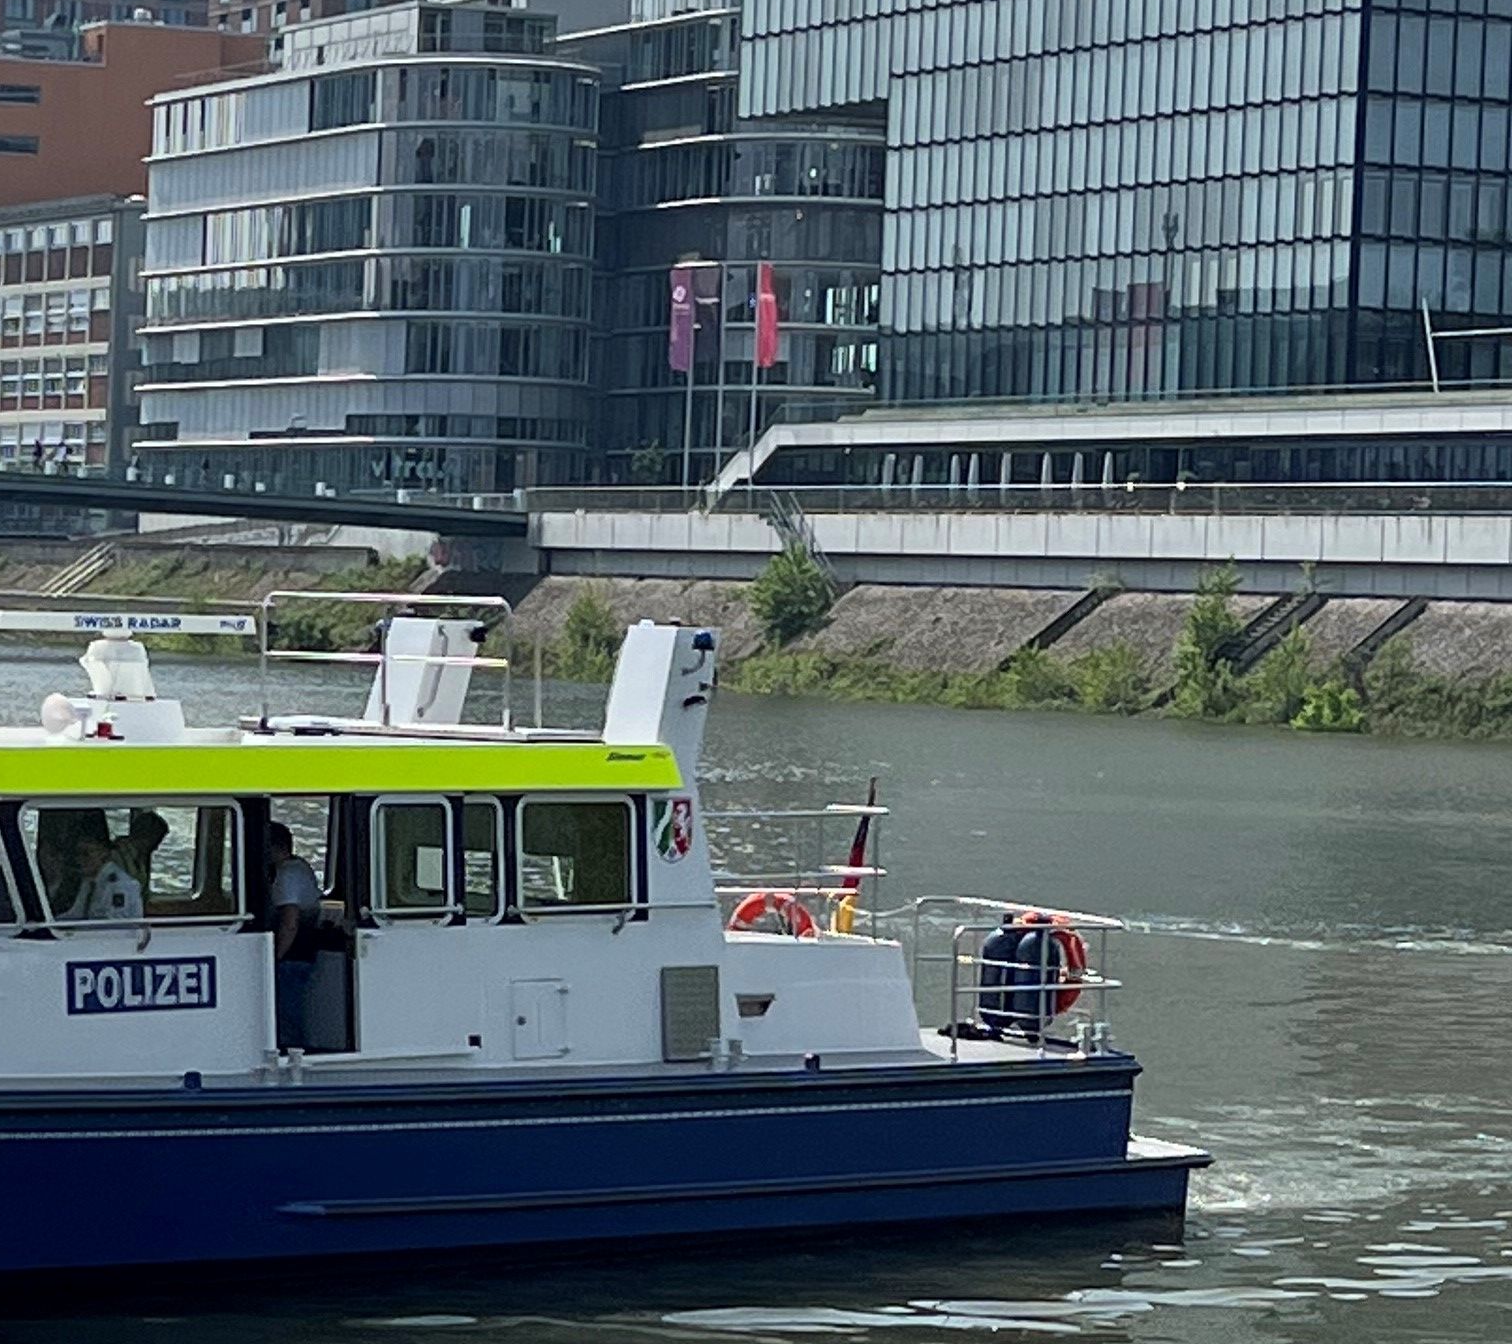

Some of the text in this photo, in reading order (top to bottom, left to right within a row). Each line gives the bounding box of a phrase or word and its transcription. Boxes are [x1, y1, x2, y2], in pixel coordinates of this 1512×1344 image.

[73, 615, 181, 630] SWISS RADAR
[74, 963, 210, 1009] POLIZEI
